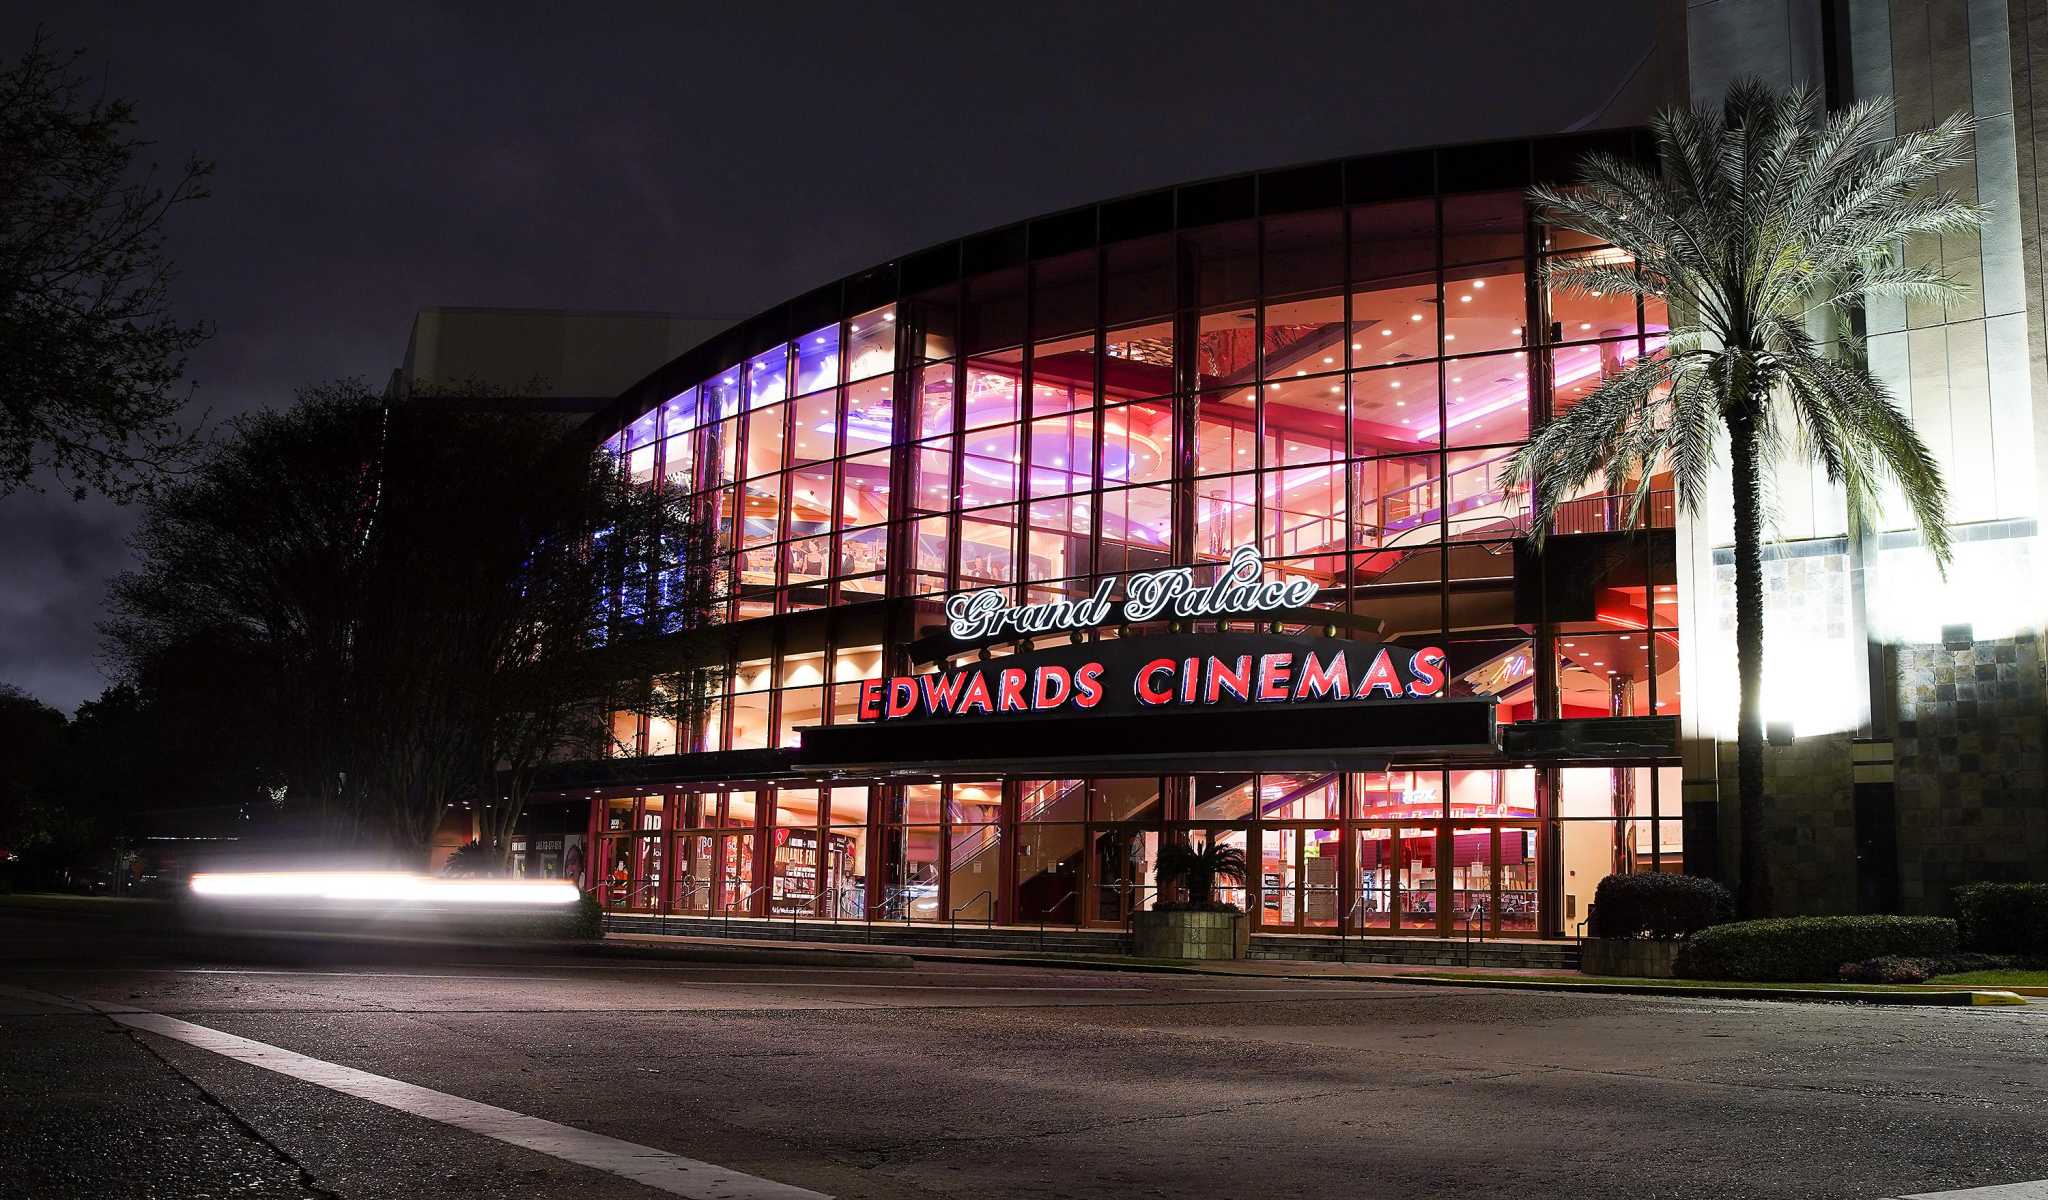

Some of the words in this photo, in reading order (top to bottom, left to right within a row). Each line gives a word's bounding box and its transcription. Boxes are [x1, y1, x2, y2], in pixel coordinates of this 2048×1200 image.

[946, 576, 1116, 640] Grand
[1124, 544, 1319, 621] Palace
[858, 662, 1104, 722] EDWARDS
[1134, 646, 1447, 706] CINEMAS
